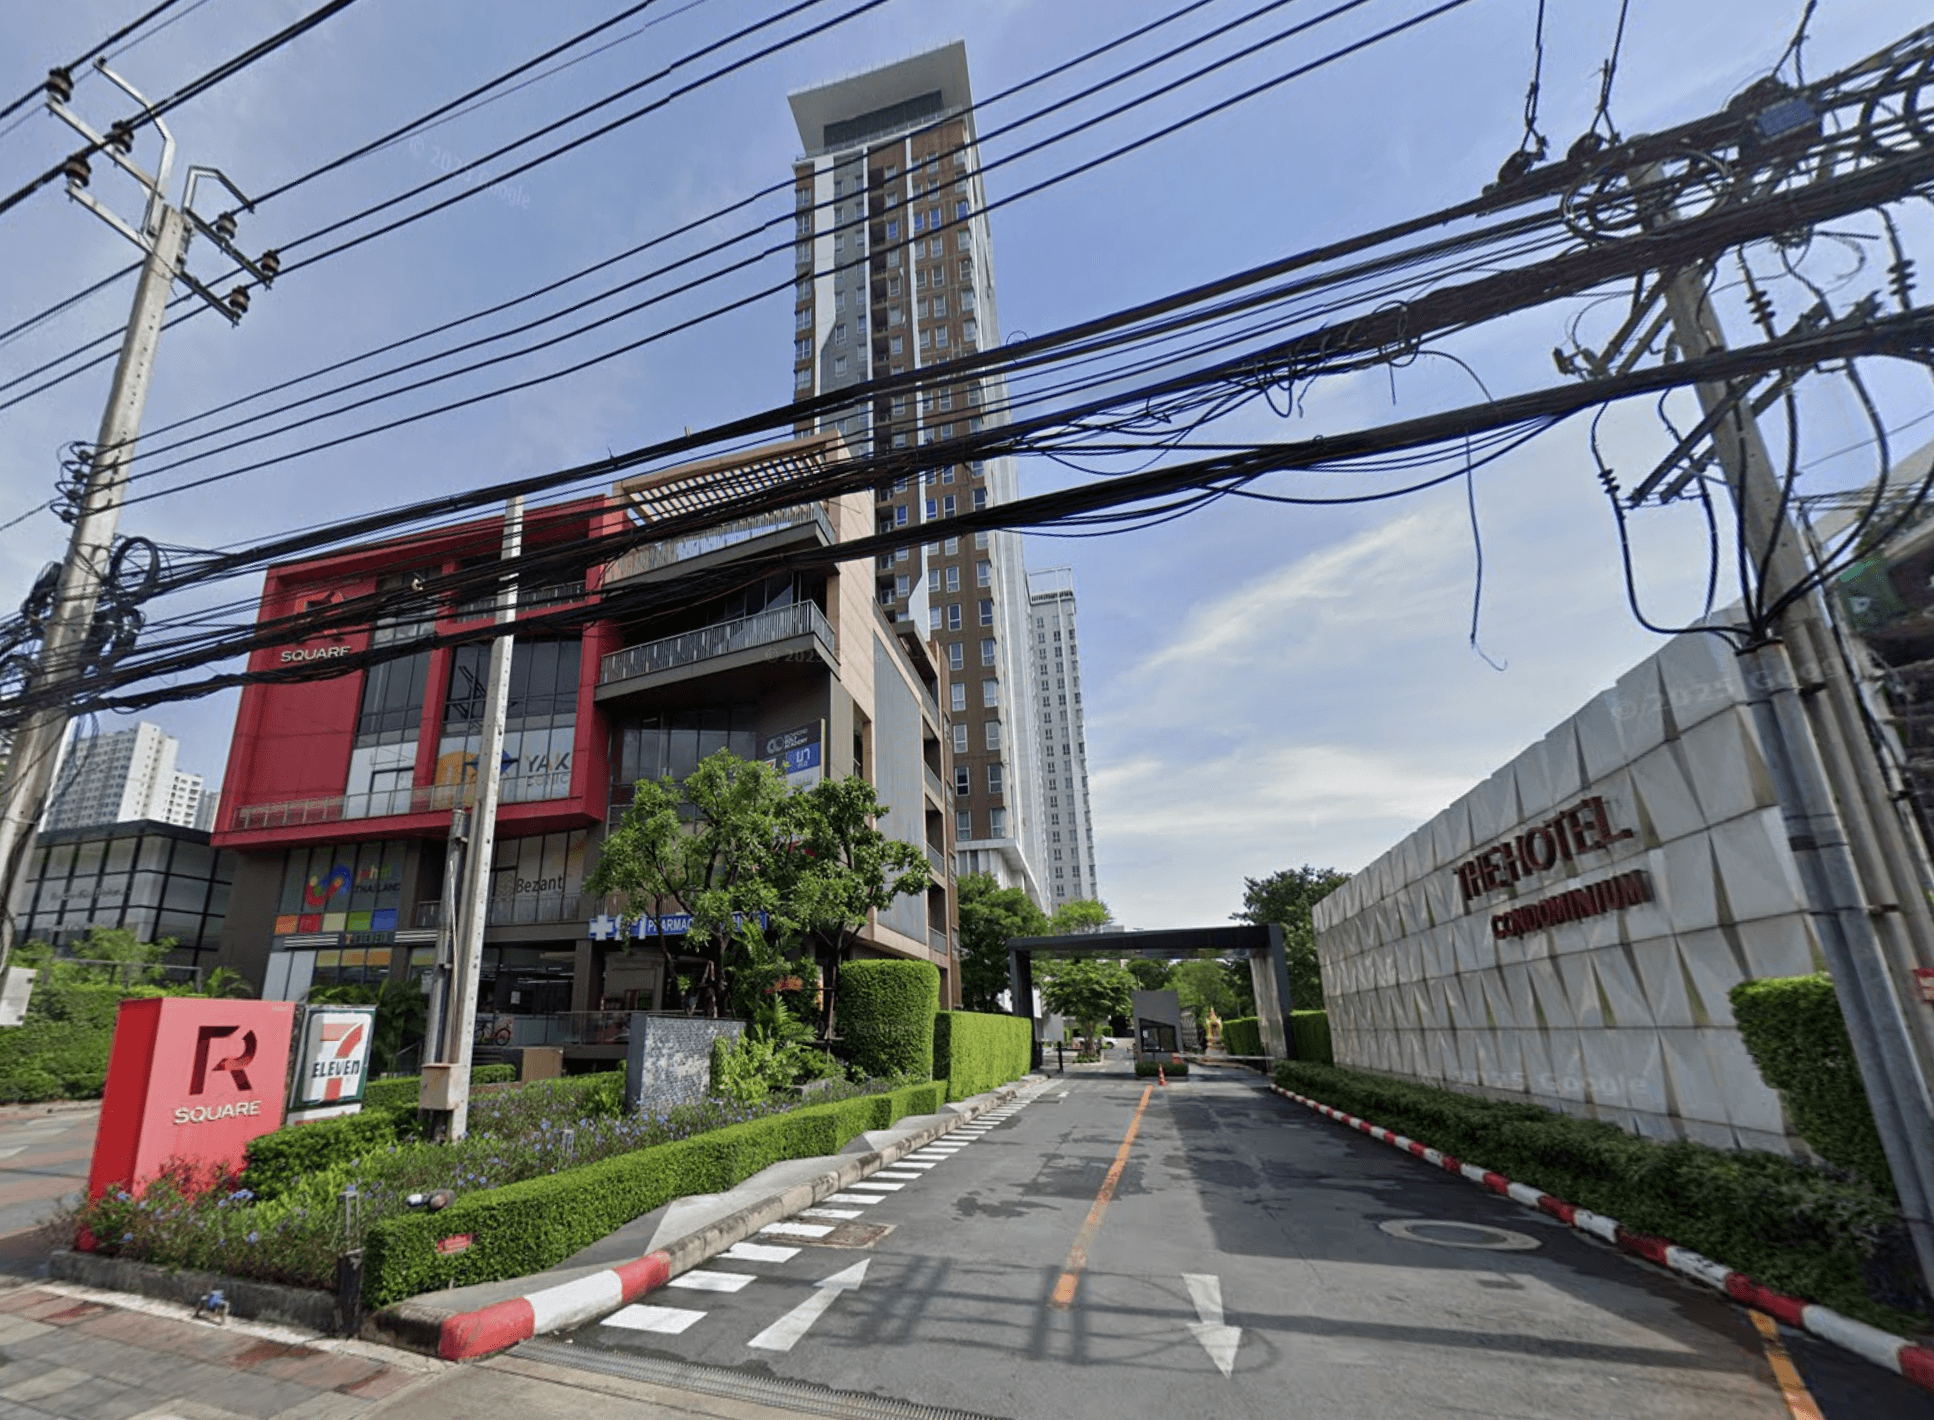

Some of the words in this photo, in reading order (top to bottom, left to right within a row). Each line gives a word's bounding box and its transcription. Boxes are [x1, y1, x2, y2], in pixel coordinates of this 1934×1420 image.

[524, 752, 570, 773] YAK
[1455, 846, 1513, 901] THE
[1501, 796, 1634, 881] HOTEL
[516, 874, 563, 893] Bezant
[1491, 870, 1650, 940] CONDOMINIUM
[647, 918, 694, 934] PARMAC
[189, 1025, 257, 1096] R
[173, 1101, 262, 1125] SQUARE
